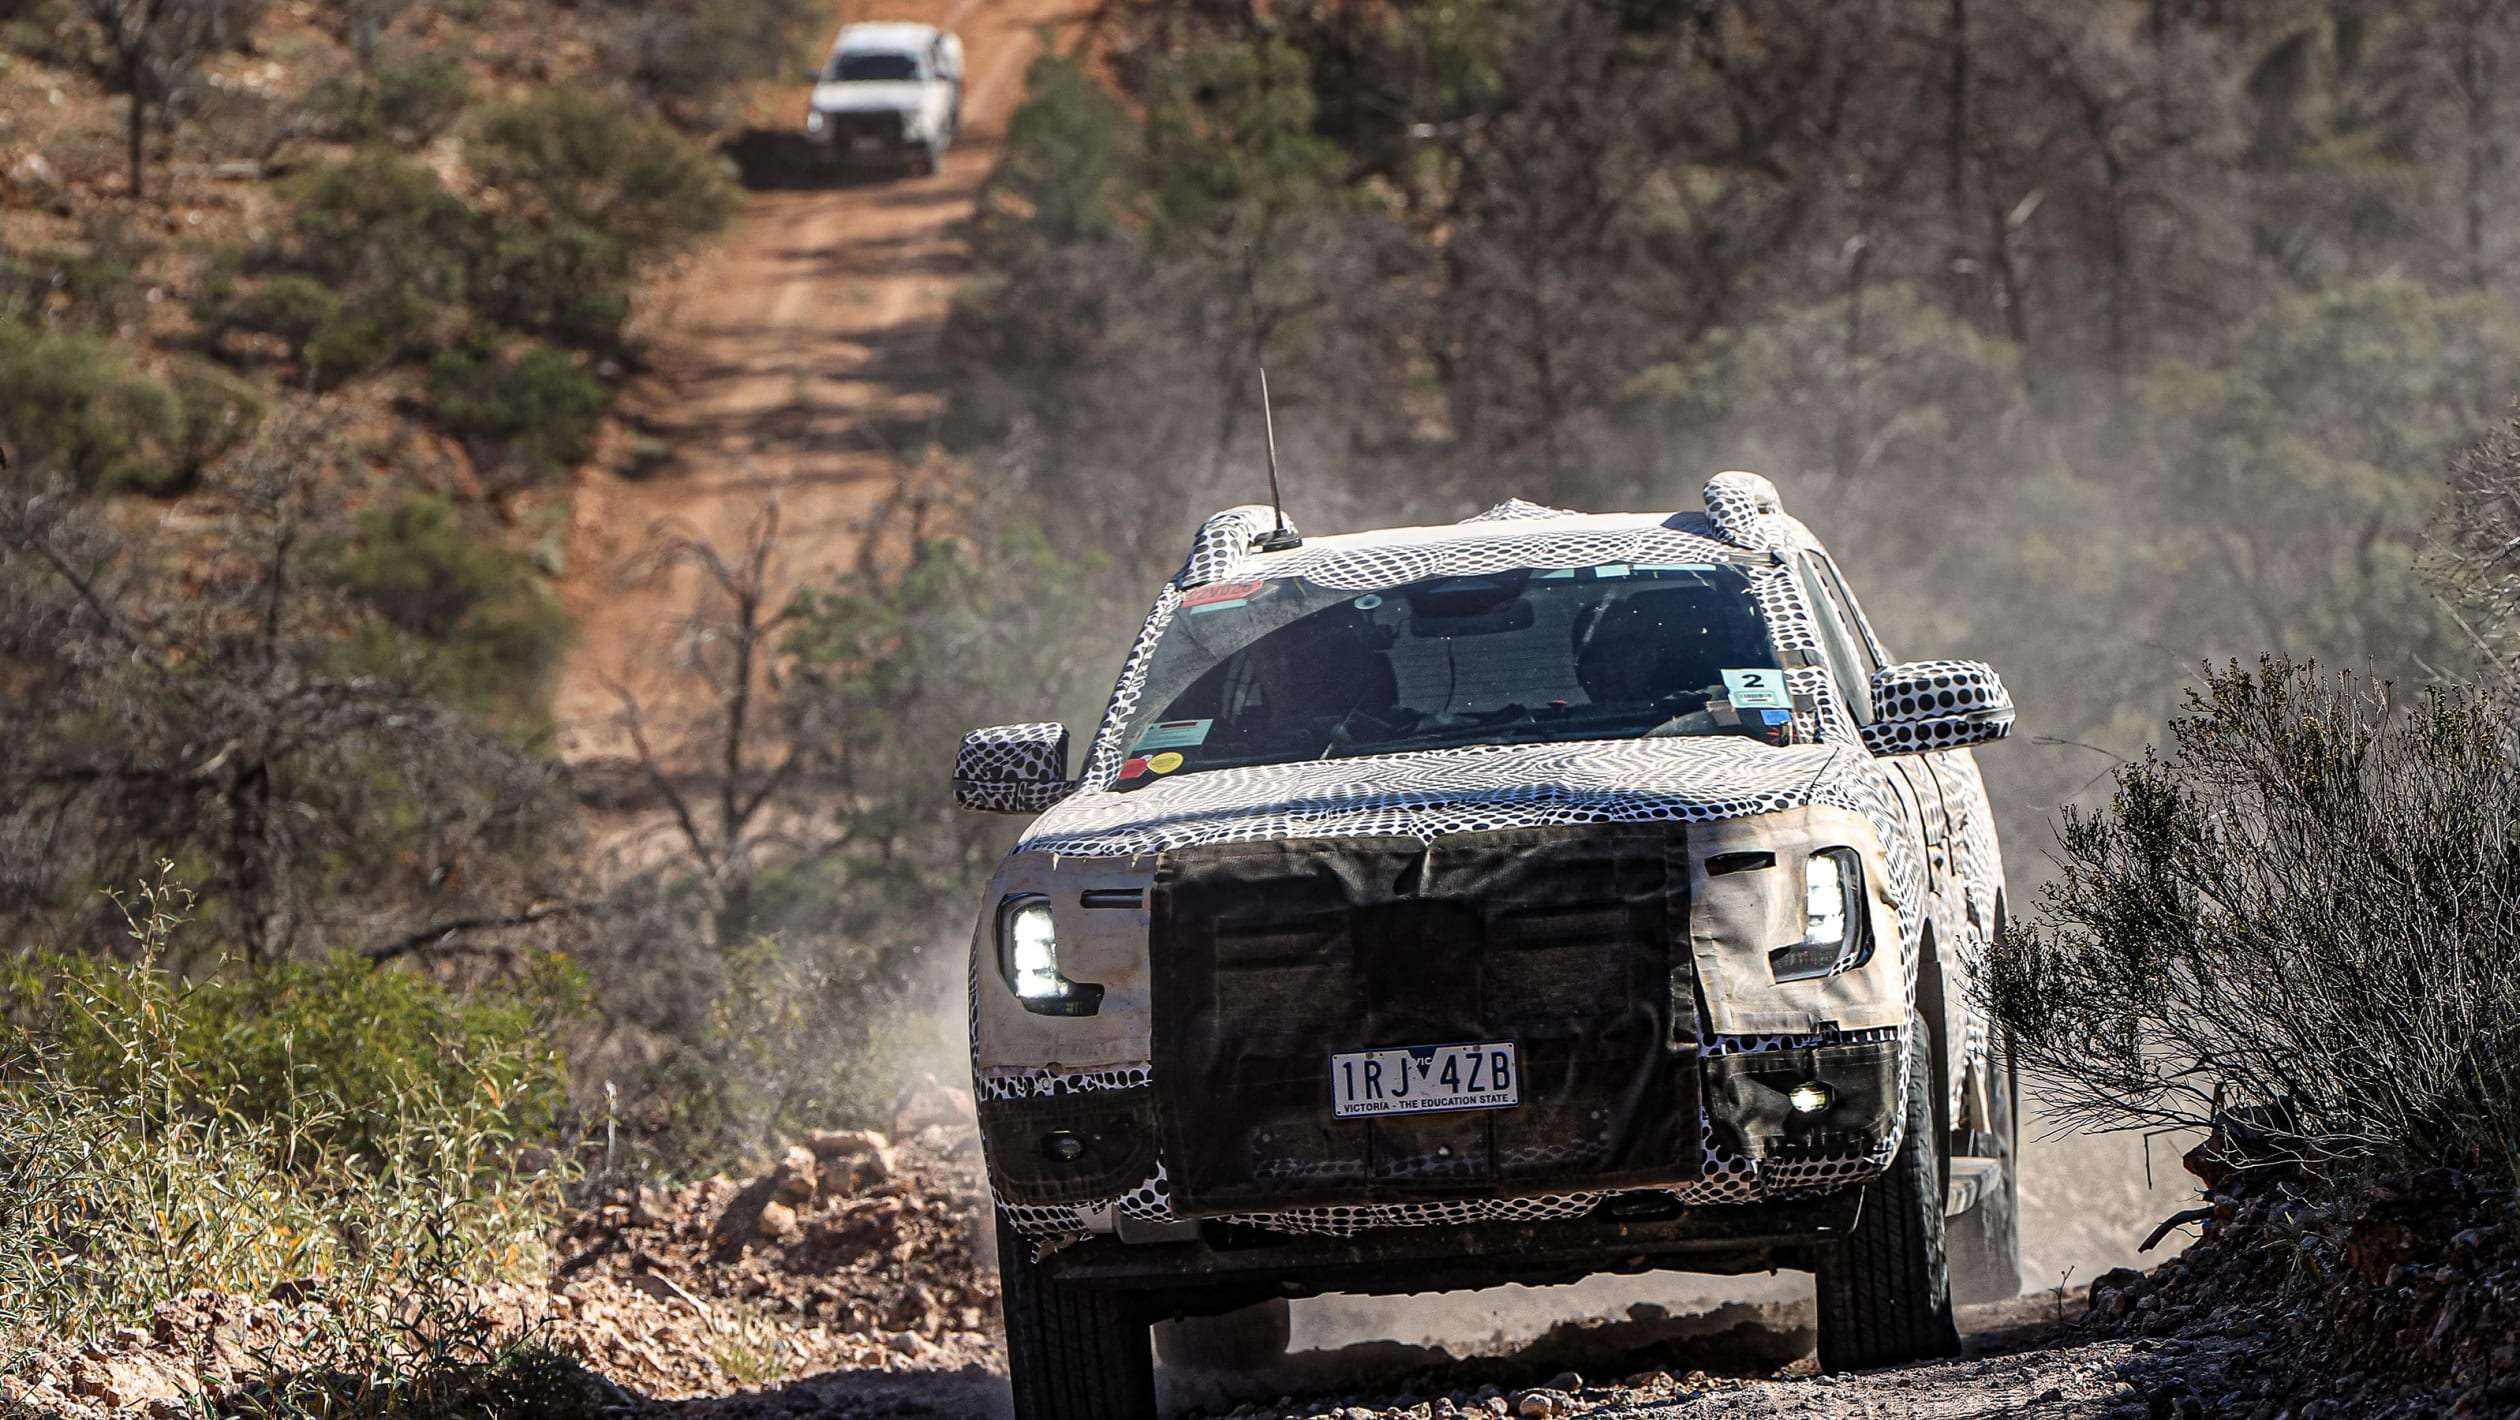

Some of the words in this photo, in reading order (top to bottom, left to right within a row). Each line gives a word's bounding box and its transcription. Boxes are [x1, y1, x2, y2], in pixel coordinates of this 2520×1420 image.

[1741, 674, 1765, 688] 2
[1342, 1057, 1409, 1101] 1RJ
[1439, 1051, 1511, 1094] 4ZB
[1343, 1102, 1390, 1113] VICTORIA
[1400, 1099, 1418, 1109] THE
[1421, 1095, 1477, 1108] EDUCATION
[1479, 1093, 1509, 1104] STATE
